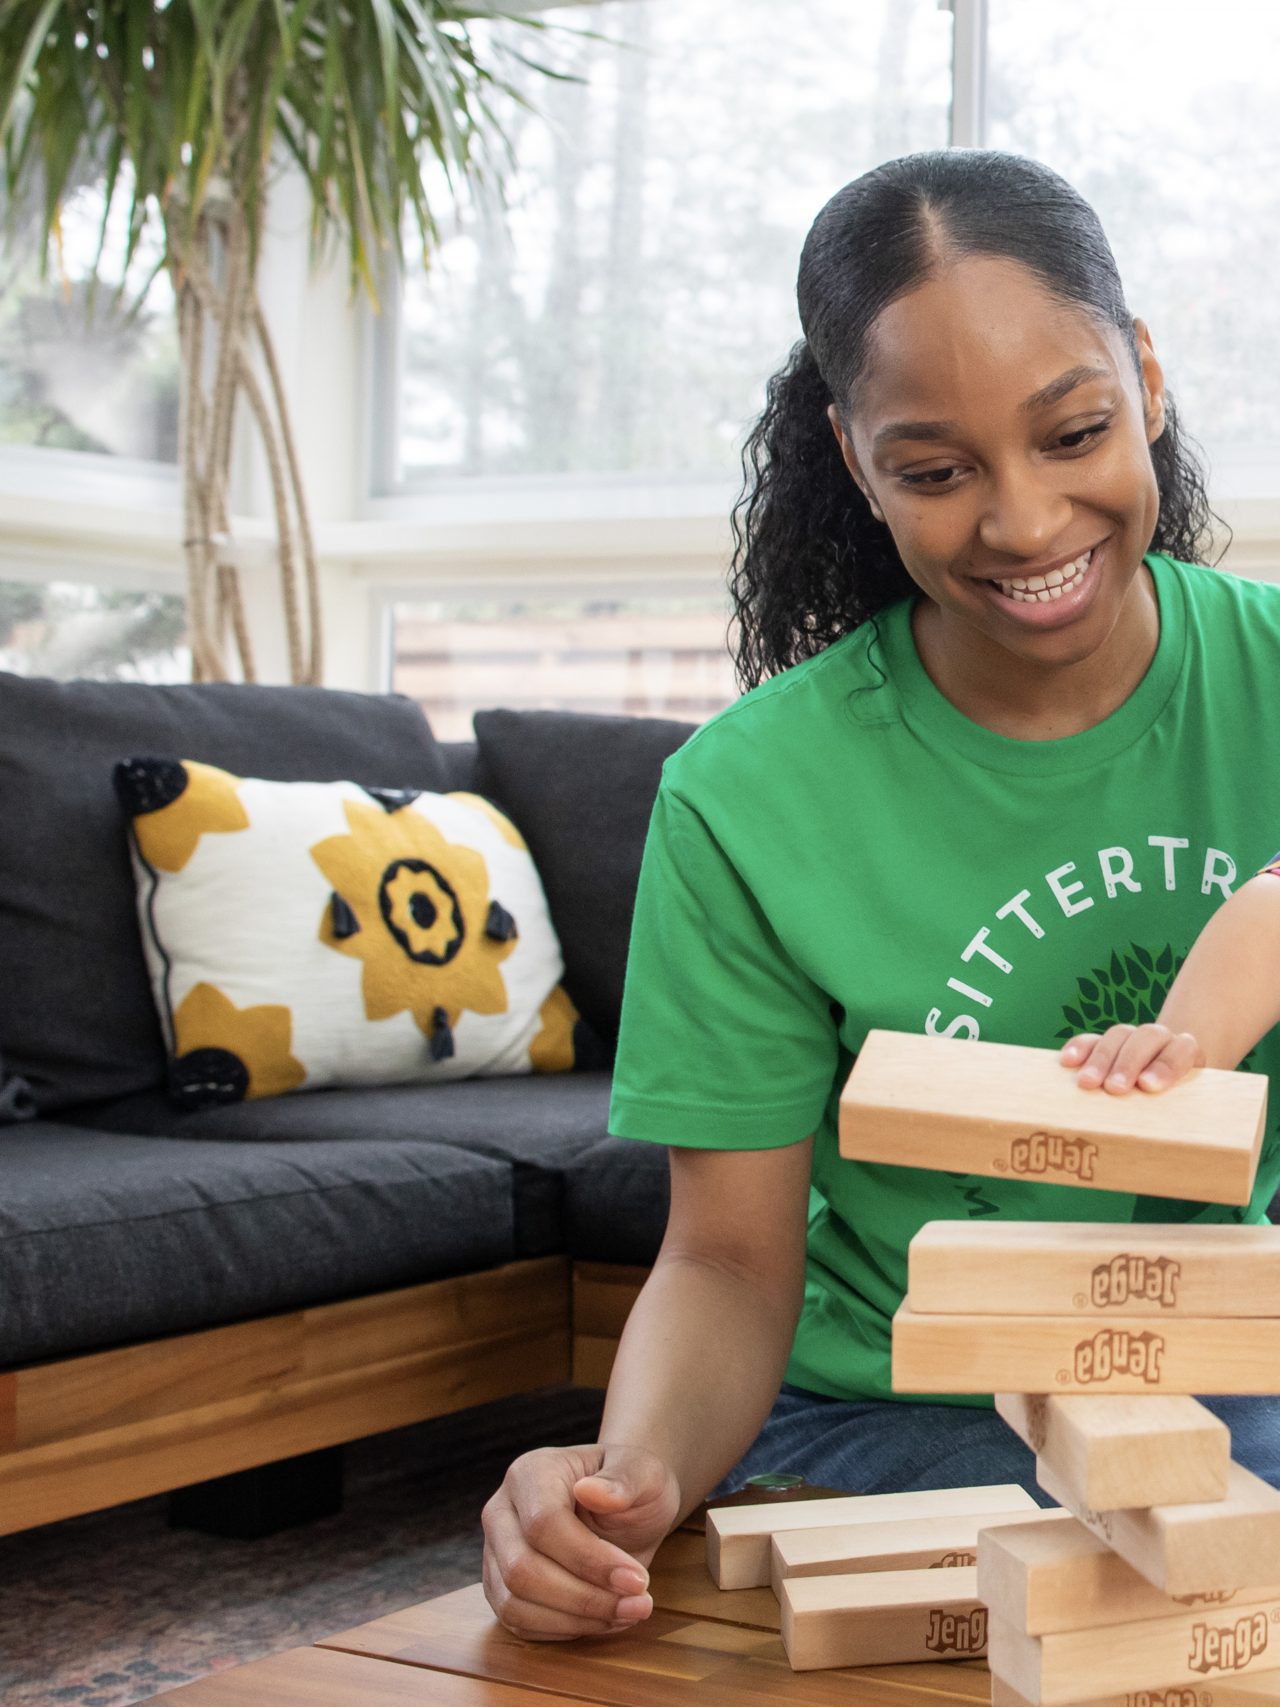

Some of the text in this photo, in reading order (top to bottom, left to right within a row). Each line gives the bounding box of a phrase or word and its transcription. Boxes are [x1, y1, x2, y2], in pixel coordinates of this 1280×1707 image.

[925, 835, 1237, 1041] SITTERTR
[1011, 1131, 1098, 1181] Jenga
[1091, 1253, 1181, 1308] Jenga
[1073, 1328, 1165, 1384] Jenga
[925, 1607, 988, 1653] Jeng
[1187, 1611, 1268, 1674] Jenga
